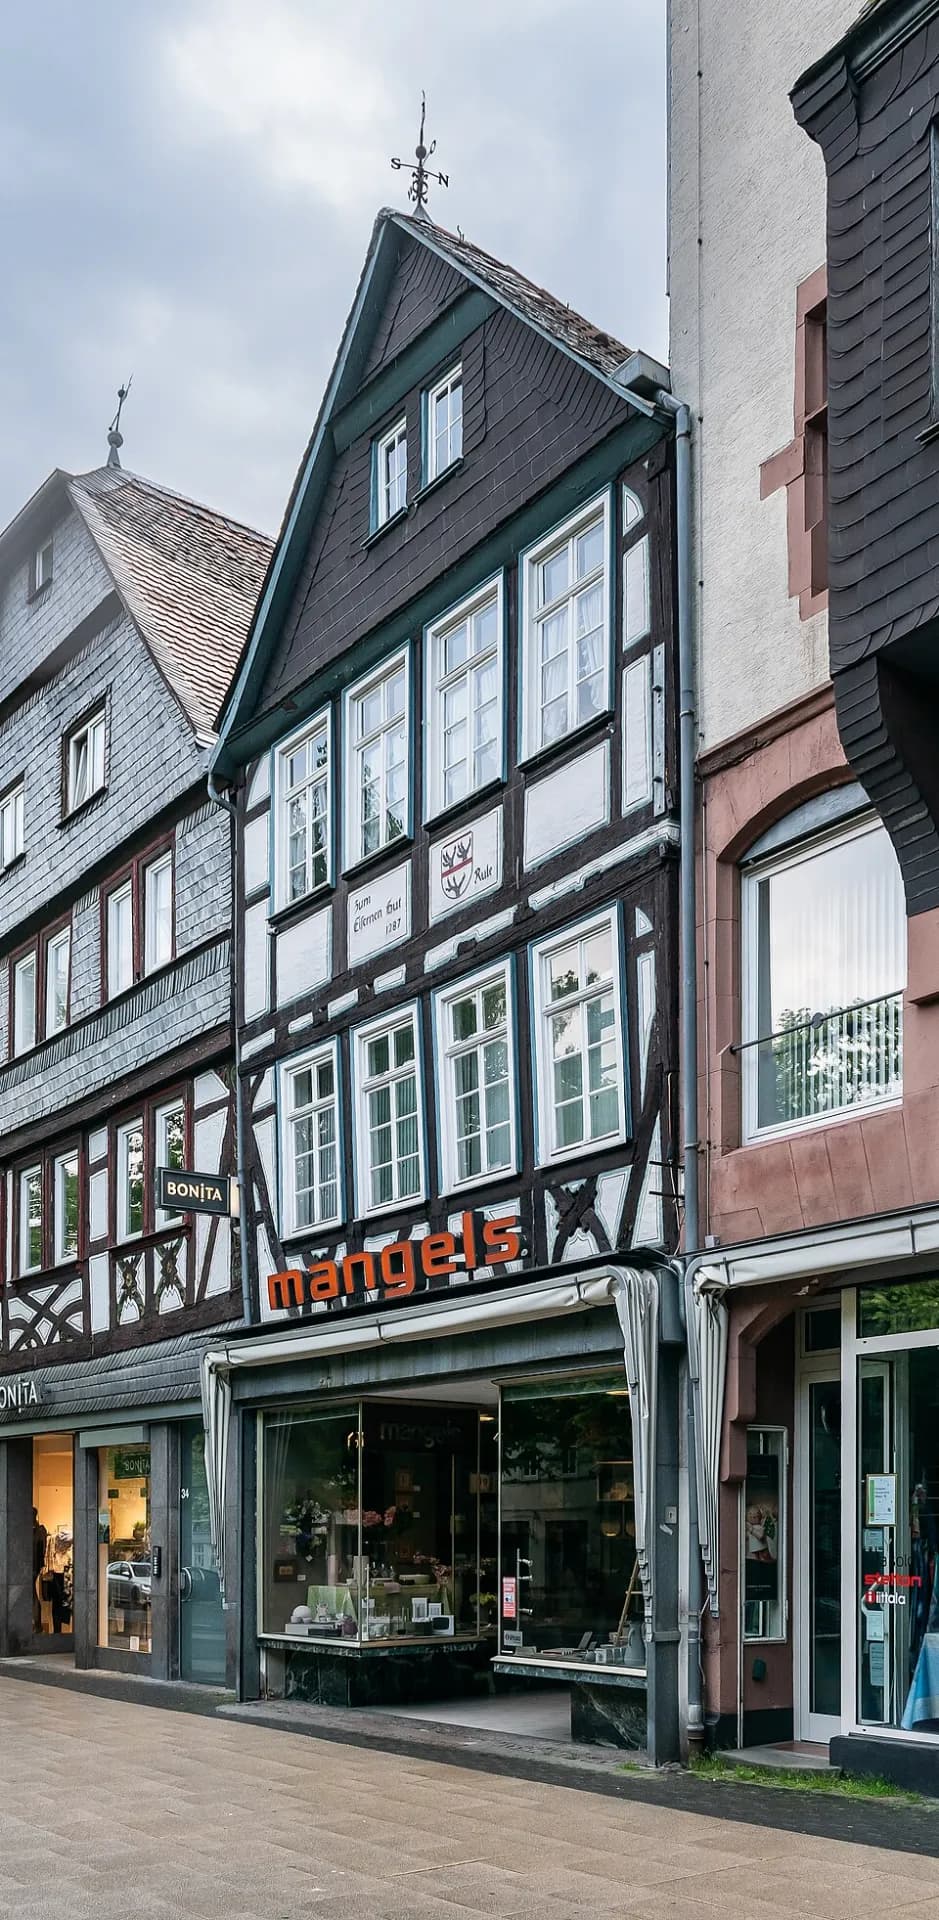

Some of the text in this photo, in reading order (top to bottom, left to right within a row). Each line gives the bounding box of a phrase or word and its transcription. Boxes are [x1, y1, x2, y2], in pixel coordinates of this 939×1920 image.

[390, 157, 401, 170] S
[438, 171, 449, 188] N
[167, 1182, 222, 1203] BONITA
[267, 1211, 521, 1311] mangels
[181, 1488, 190, 1499] 34
